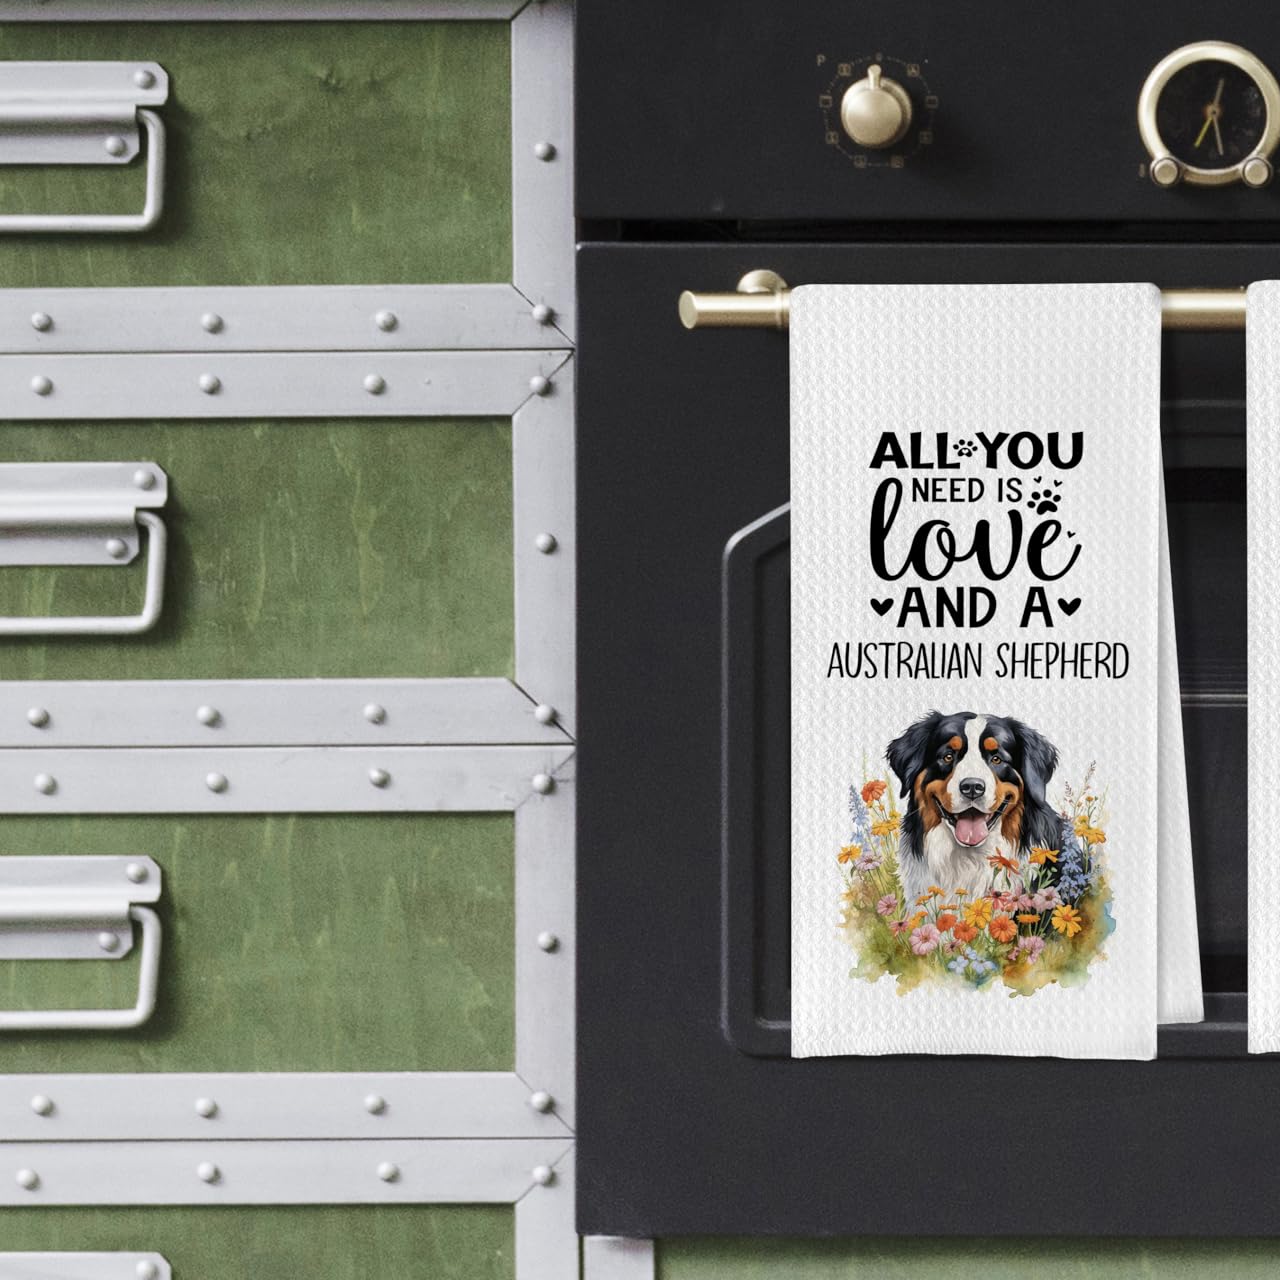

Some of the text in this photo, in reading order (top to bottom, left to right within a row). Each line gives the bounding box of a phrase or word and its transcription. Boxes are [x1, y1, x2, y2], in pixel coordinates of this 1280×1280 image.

[869, 431, 1084, 470] ALL YOU
[912, 477, 1023, 503] NEED IS
[869, 477, 1082, 581] love
[896, 586, 1054, 628] AND A
[827, 641, 1130, 679] AUSTRALIAN SHEPHERD
